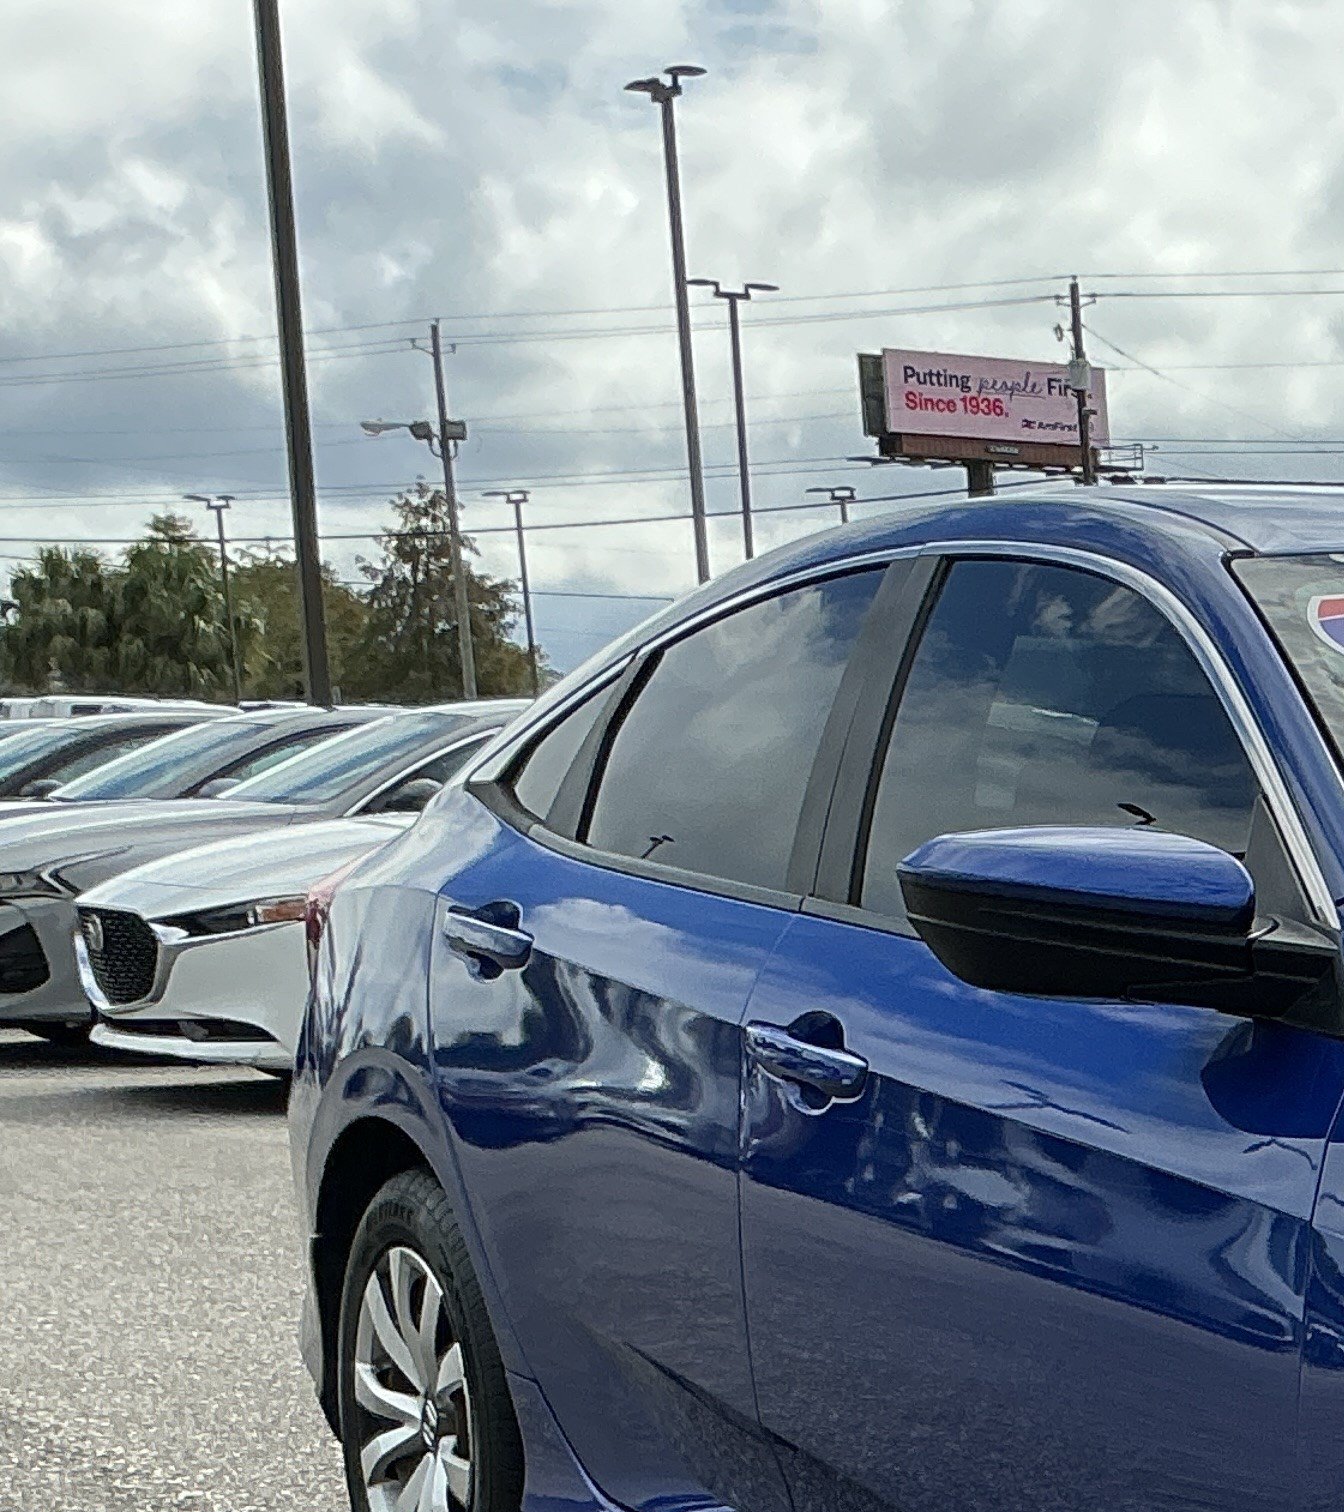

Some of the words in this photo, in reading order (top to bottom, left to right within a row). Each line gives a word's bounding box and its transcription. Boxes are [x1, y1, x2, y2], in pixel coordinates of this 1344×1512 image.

[903, 365, 971, 393] Putting
[976, 371, 1044, 399] people
[905, 391, 957, 414] Since
[962, 395, 1009, 418] 1936.
